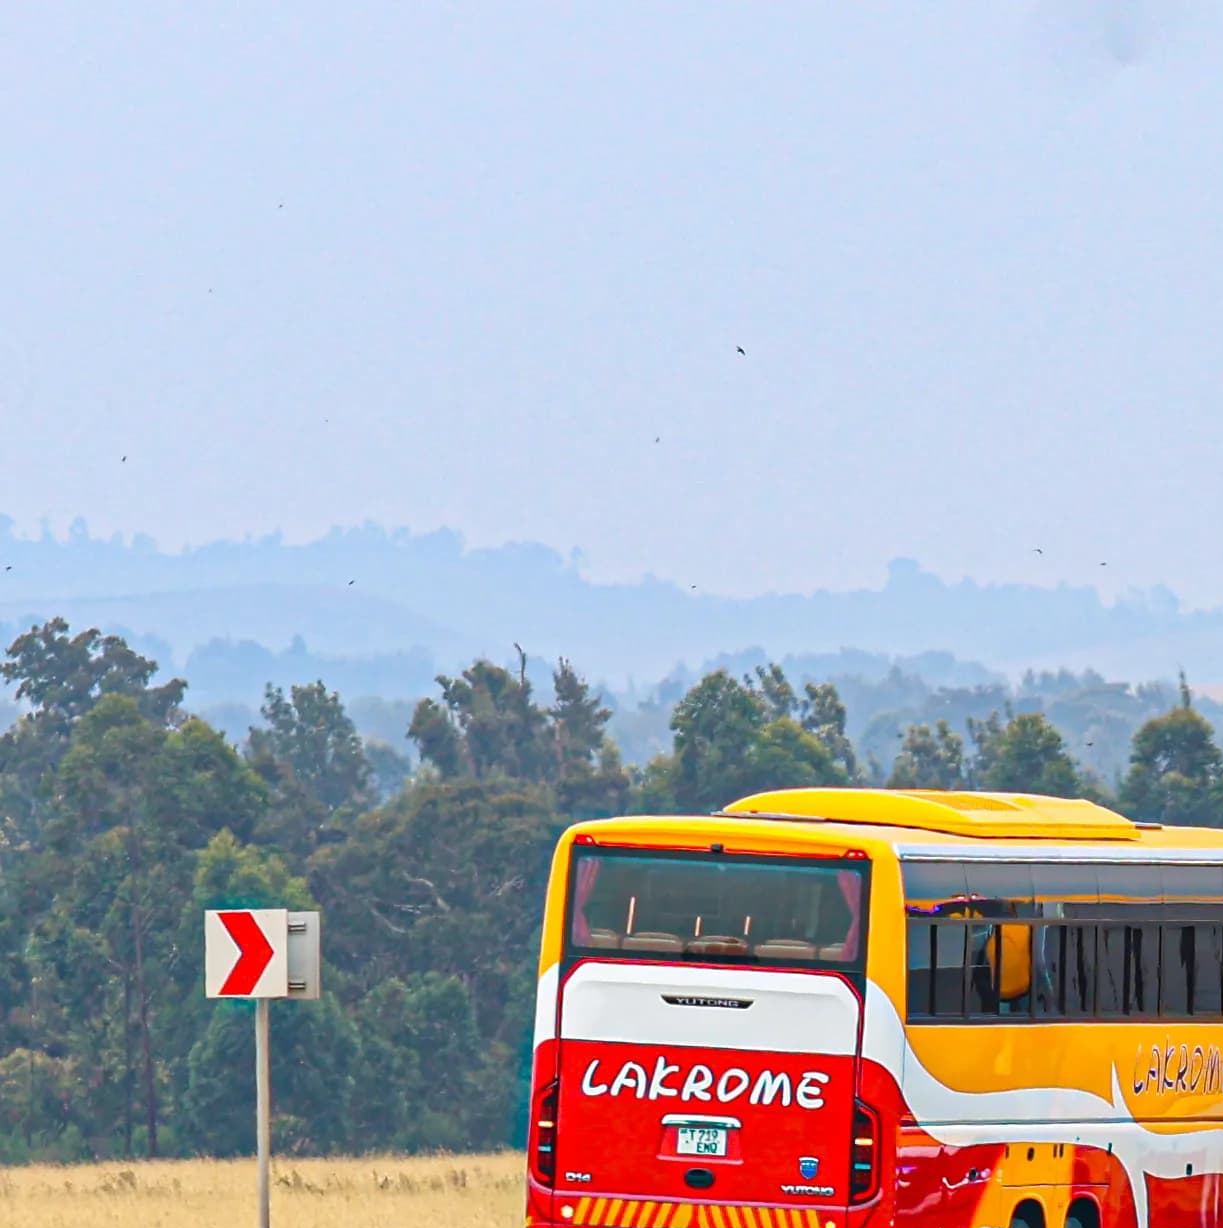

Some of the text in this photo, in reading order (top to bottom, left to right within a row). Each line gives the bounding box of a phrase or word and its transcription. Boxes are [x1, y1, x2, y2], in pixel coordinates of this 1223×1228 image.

[676, 998, 739, 1007] YUTONG
[581, 1056, 830, 1109] LAKROME
[689, 1129, 696, 1141] T
[780, 1185, 835, 1197] YUTONG
